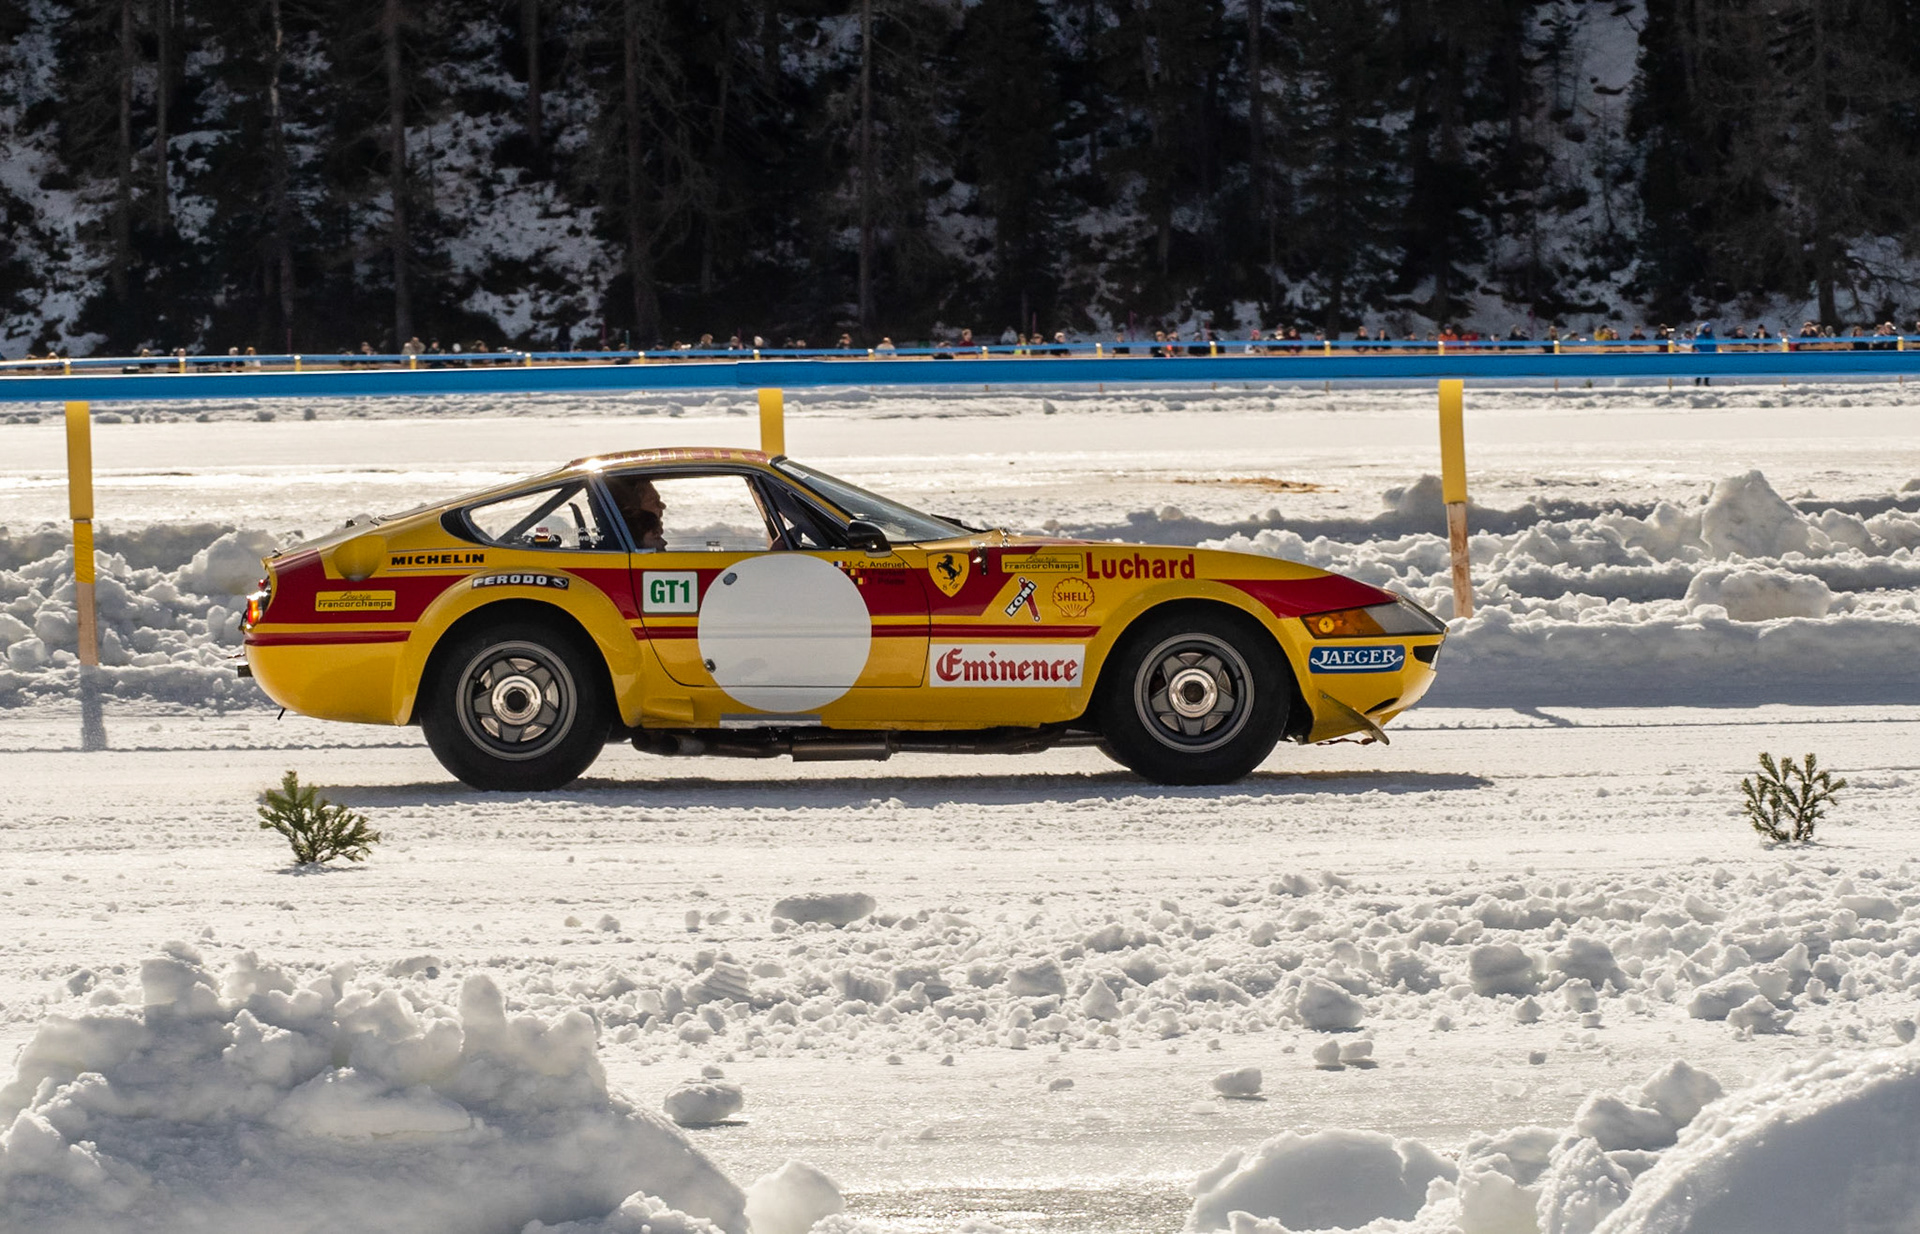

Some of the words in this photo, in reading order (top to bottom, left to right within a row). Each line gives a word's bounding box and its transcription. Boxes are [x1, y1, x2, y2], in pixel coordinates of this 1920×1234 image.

[391, 553, 485, 566] MICHELIN
[869, 560, 906, 569] Andruet
[1085, 551, 1195, 579] Luchard
[650, 579, 690, 604] GT1
[1006, 582, 1036, 615] KONI
[1057, 592, 1089, 602] SHELL
[935, 647, 1078, 682] Eminence
[1320, 649, 1397, 665] JAEGER
